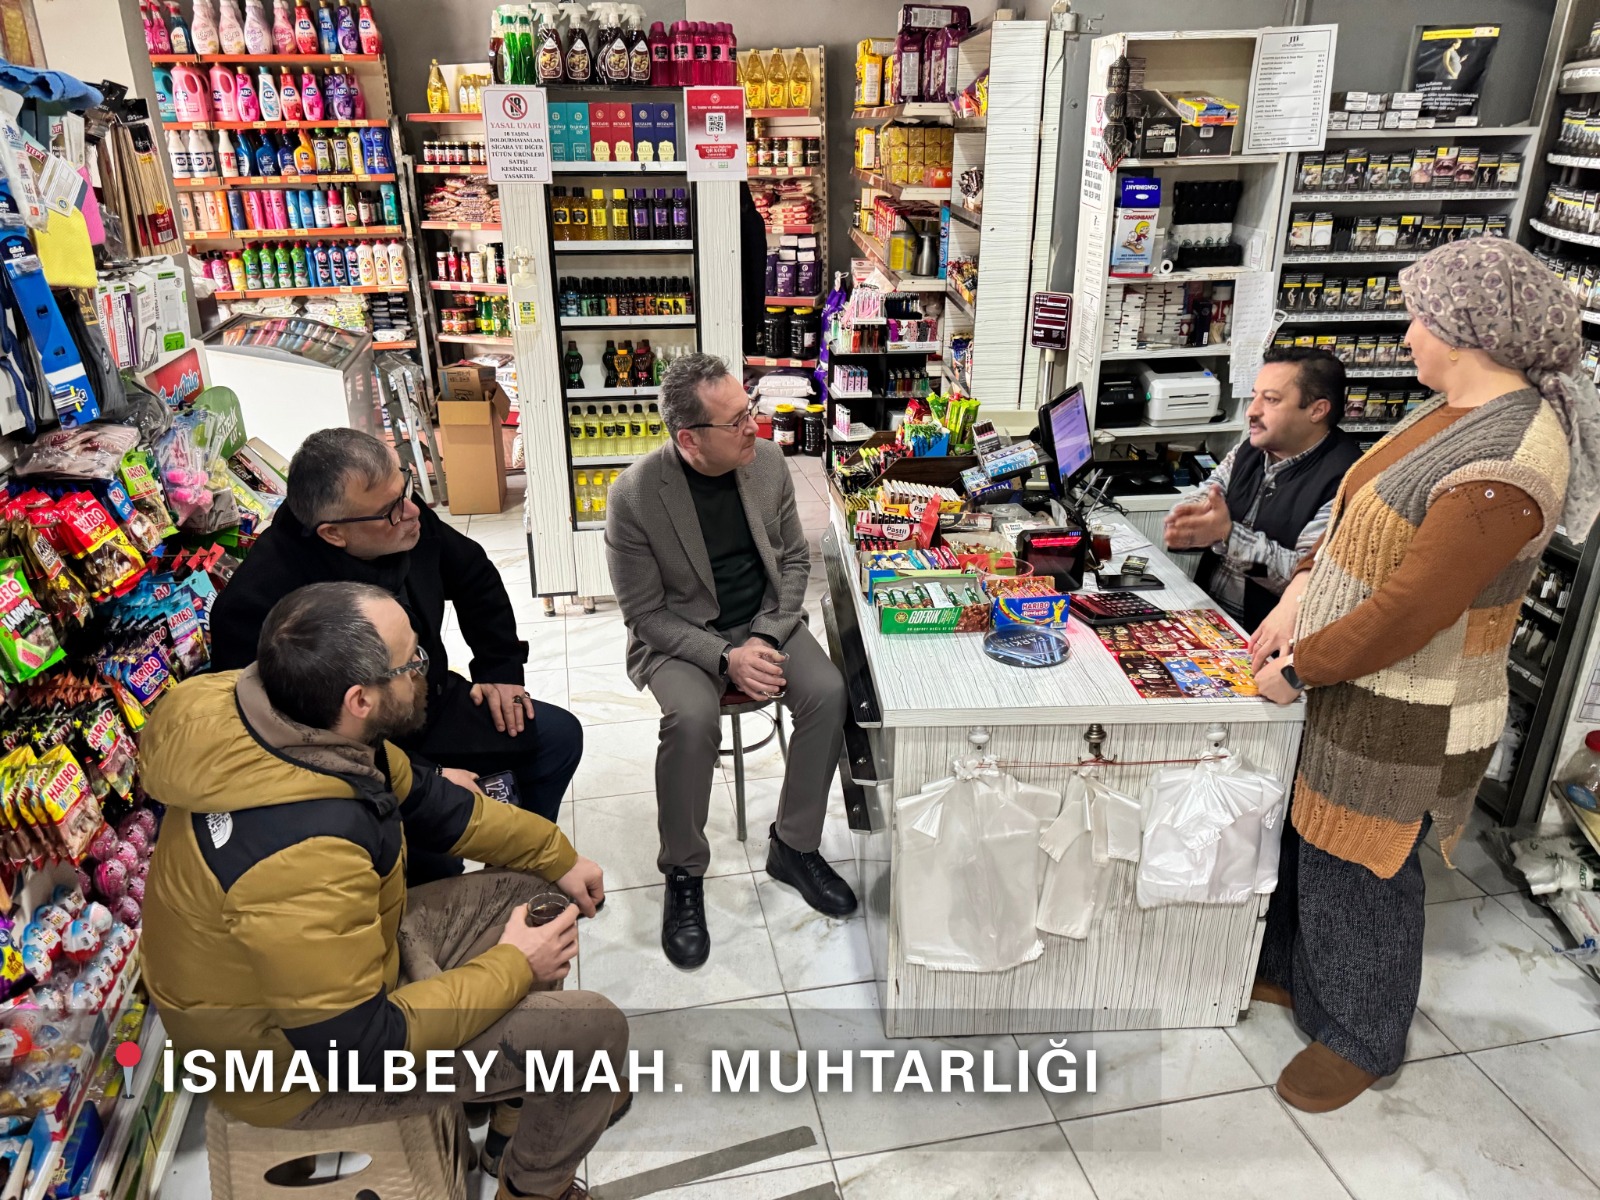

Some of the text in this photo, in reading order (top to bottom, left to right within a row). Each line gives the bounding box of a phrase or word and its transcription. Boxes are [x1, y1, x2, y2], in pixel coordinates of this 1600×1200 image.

[25, 143, 46, 161] STEPY
[233, 462, 253, 481] First
[886, 525, 907, 535] Pastil
[2, 598, 35, 632] KARPUZ
[1022, 602, 1050, 610] HARIBO
[129, 656, 161, 688] HARIBO
[87, 708, 114, 751] HARIBO
[46, 762, 79, 802] HARIBO
